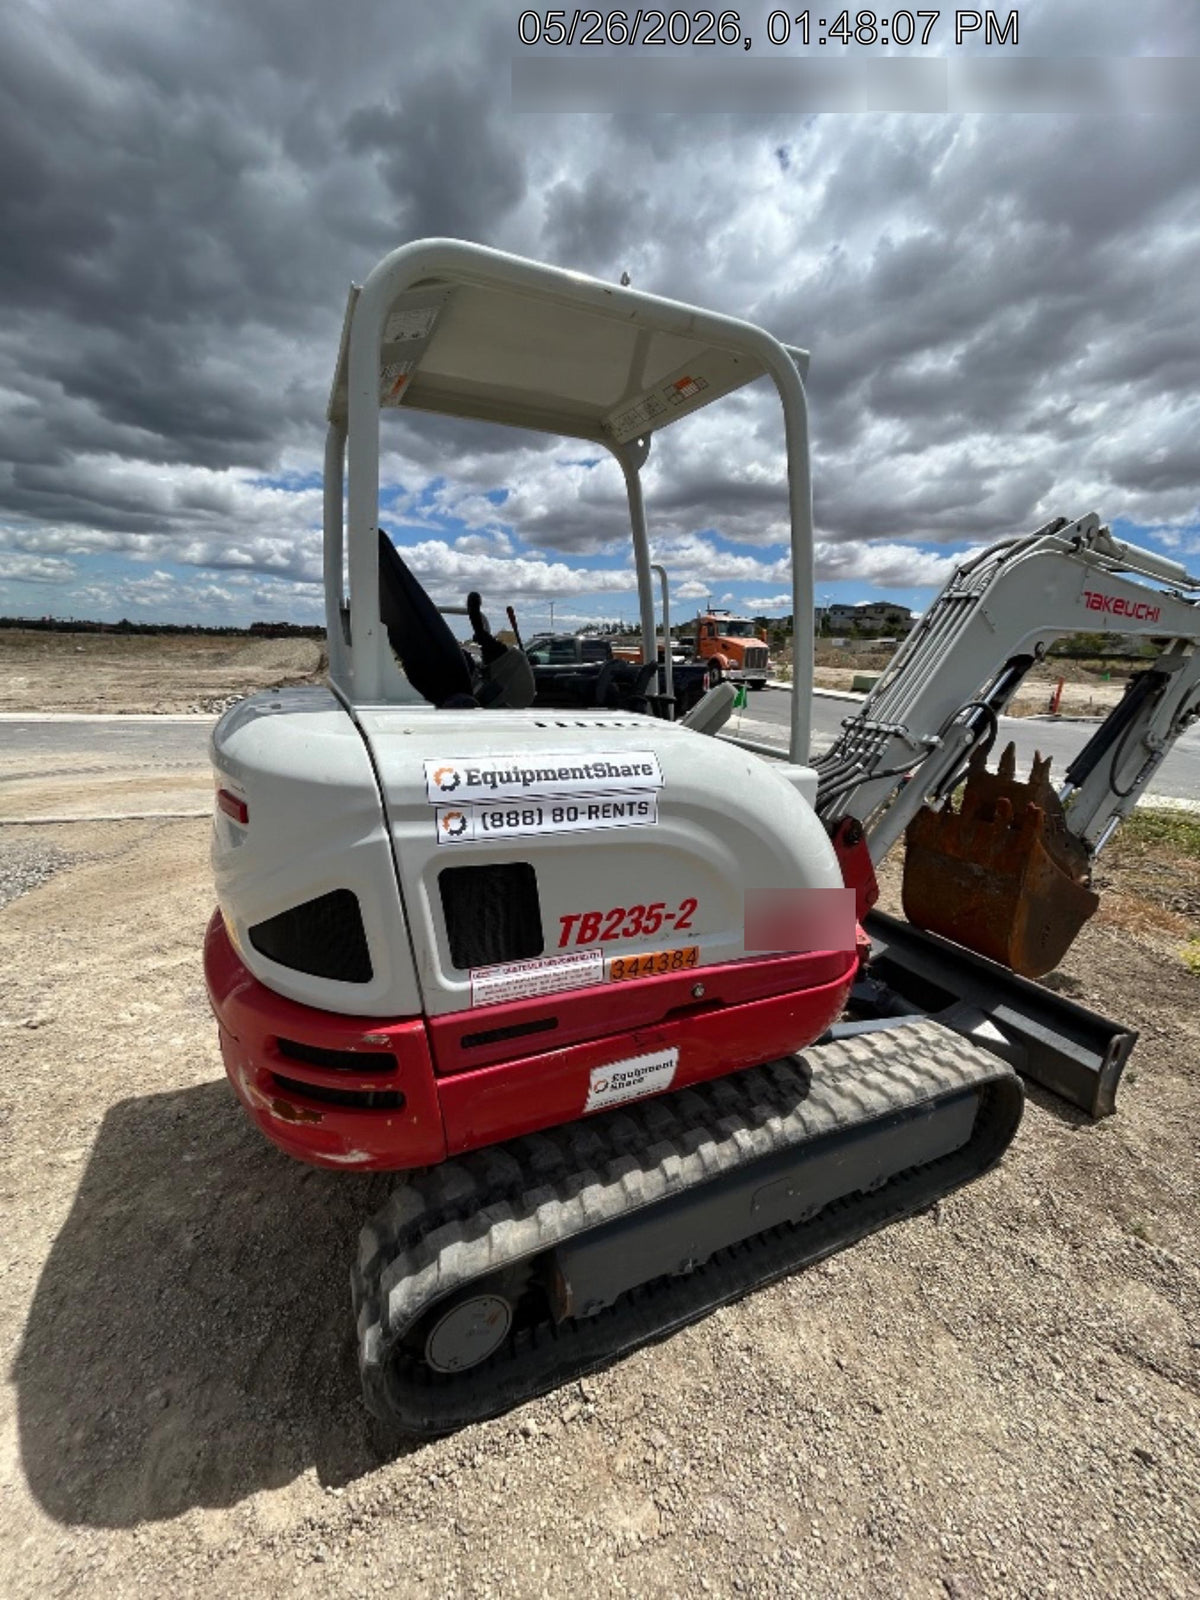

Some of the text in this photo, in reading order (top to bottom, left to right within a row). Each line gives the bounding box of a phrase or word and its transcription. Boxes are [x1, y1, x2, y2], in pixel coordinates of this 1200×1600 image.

[465, 762, 653, 790] EquipmentShare
[481, 801, 649, 830] (888) 80-RENTS
[558, 897, 698, 948] TB235-2
[612, 947, 697, 980] 344384
